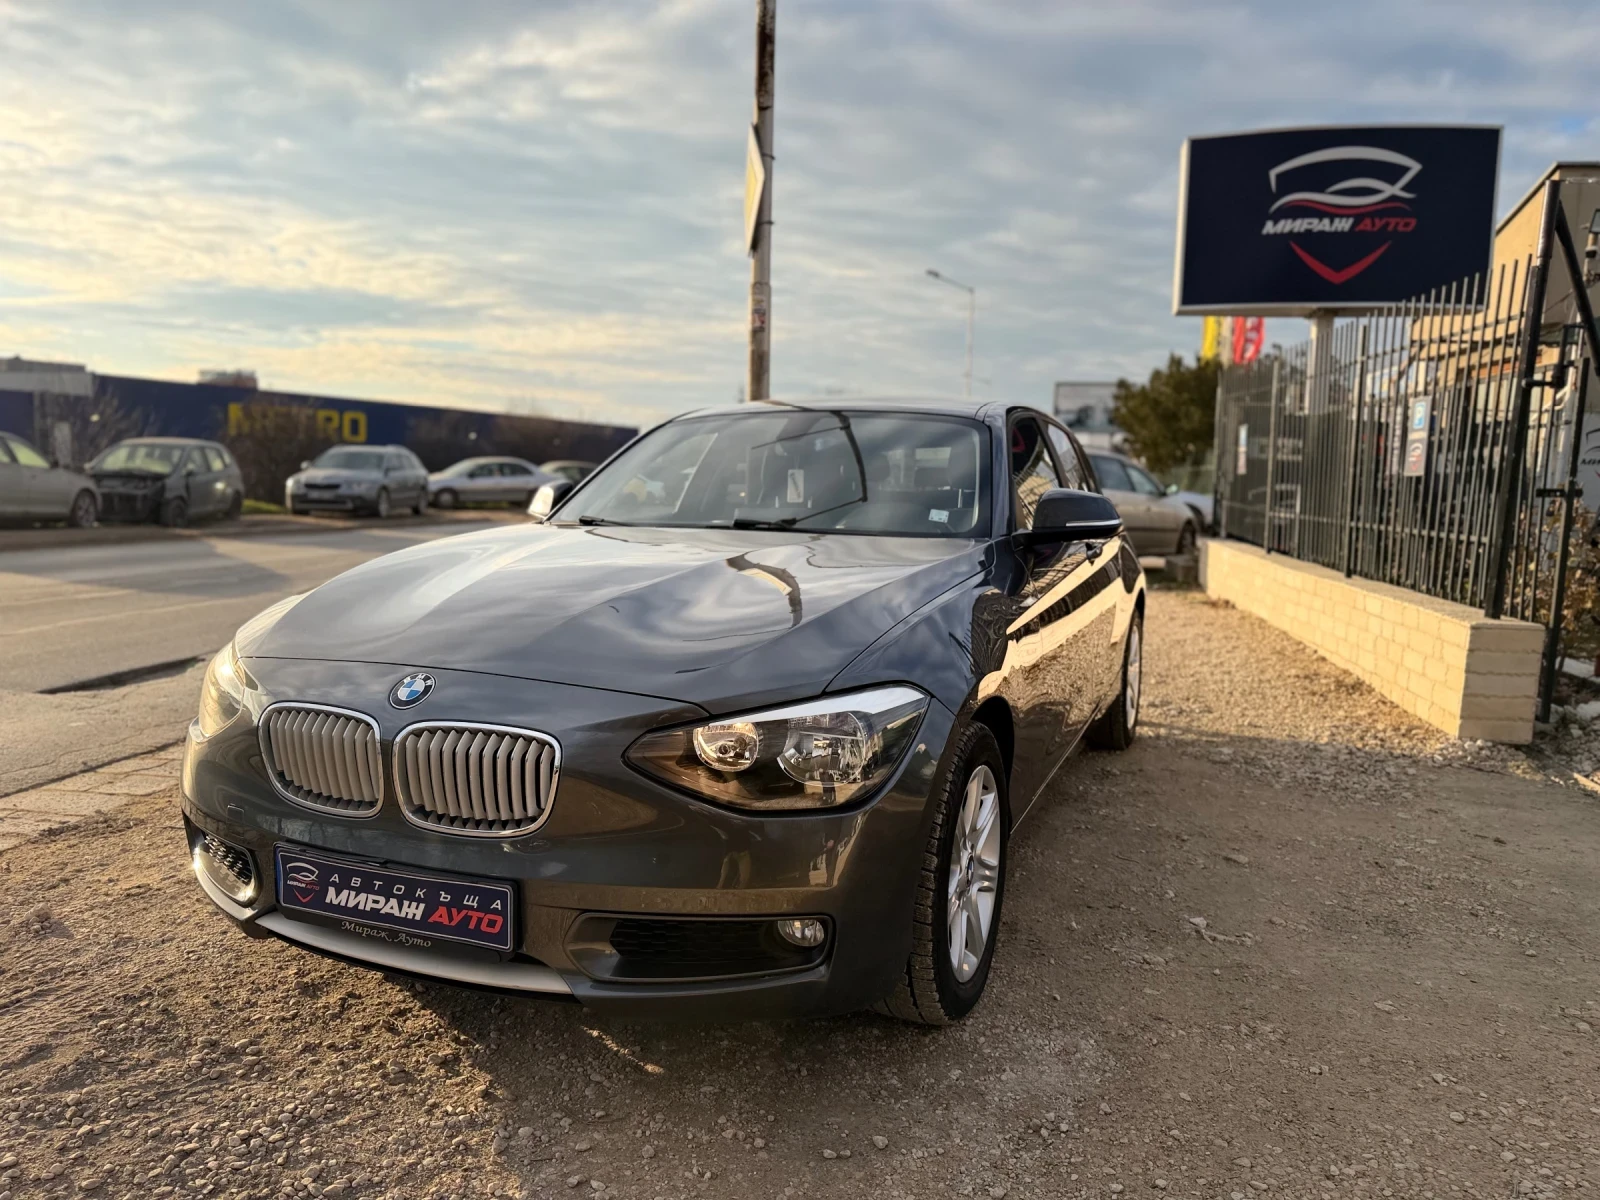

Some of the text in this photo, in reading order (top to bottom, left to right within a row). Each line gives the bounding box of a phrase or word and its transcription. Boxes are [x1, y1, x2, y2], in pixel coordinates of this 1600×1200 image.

[1261, 217, 1417, 235] МИРАЖ АУТО
[228, 402, 367, 443] MRO
[325, 886, 503, 934] МИРАЖ АУТО
[329, 873, 502, 910] АВТОКЪЩА
[341, 921, 432, 948] Мираж Ауто
